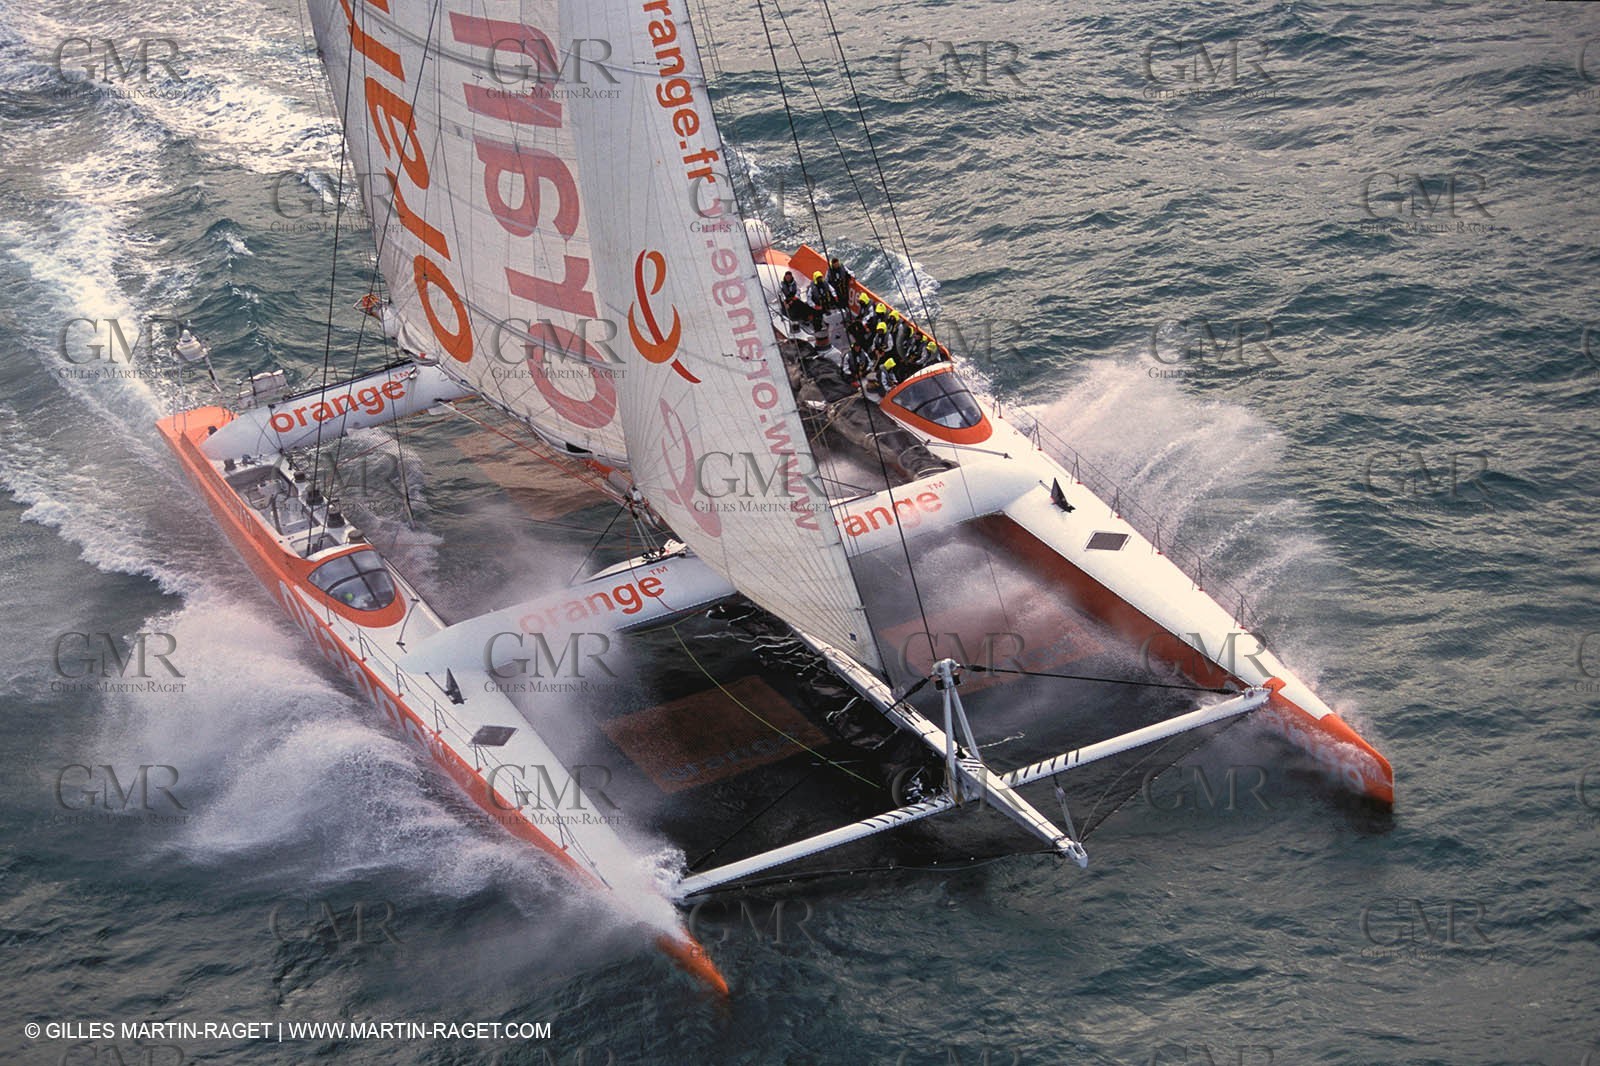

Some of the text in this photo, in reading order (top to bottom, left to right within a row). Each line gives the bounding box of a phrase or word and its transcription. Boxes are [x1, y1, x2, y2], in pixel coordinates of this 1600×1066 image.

[269, 380, 407, 433] orange
[834, 491, 943, 537] ange
[519, 576, 665, 634] orange
